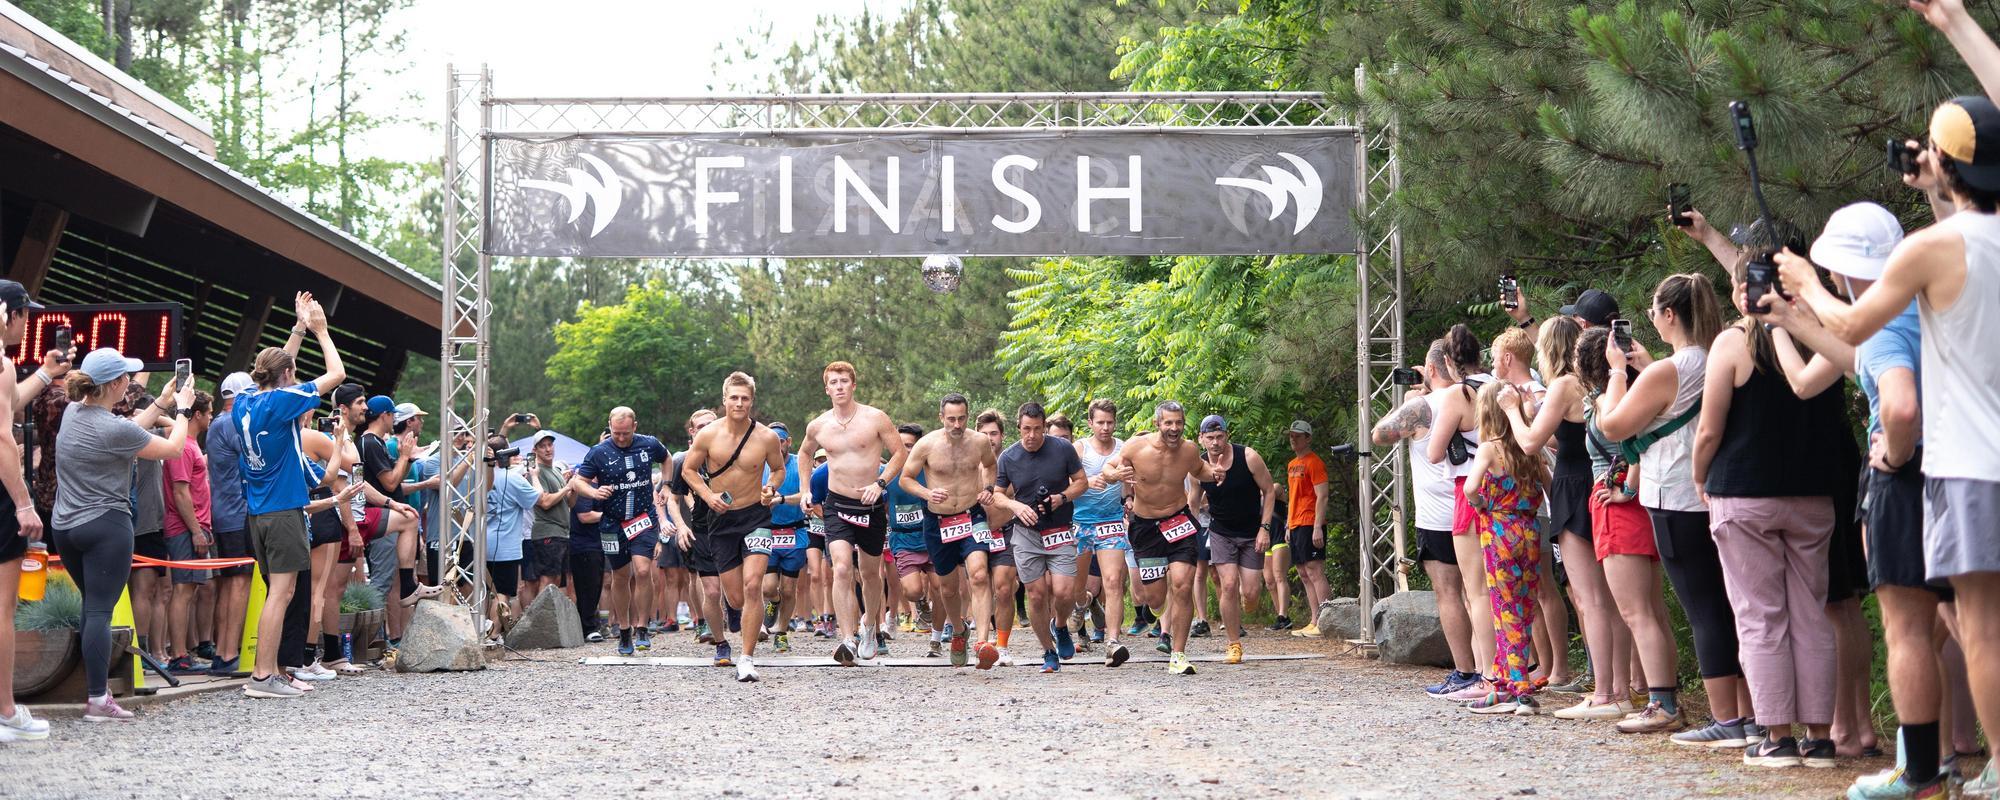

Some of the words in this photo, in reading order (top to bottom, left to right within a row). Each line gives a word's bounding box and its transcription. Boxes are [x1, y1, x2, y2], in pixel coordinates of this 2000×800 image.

[695, 154, 1142, 235] FINISH
[898, 511, 920, 523] 2081
[626, 519, 650, 535] 1718
[942, 524, 971, 538] 1735
[1098, 524, 1123, 535] 1733
[1165, 522, 1193, 539] 1732
[747, 536, 772, 550] 2242
[772, 536, 794, 544] 1727
[1044, 532, 1071, 545] 1714
[1141, 566, 1168, 579] 2314
